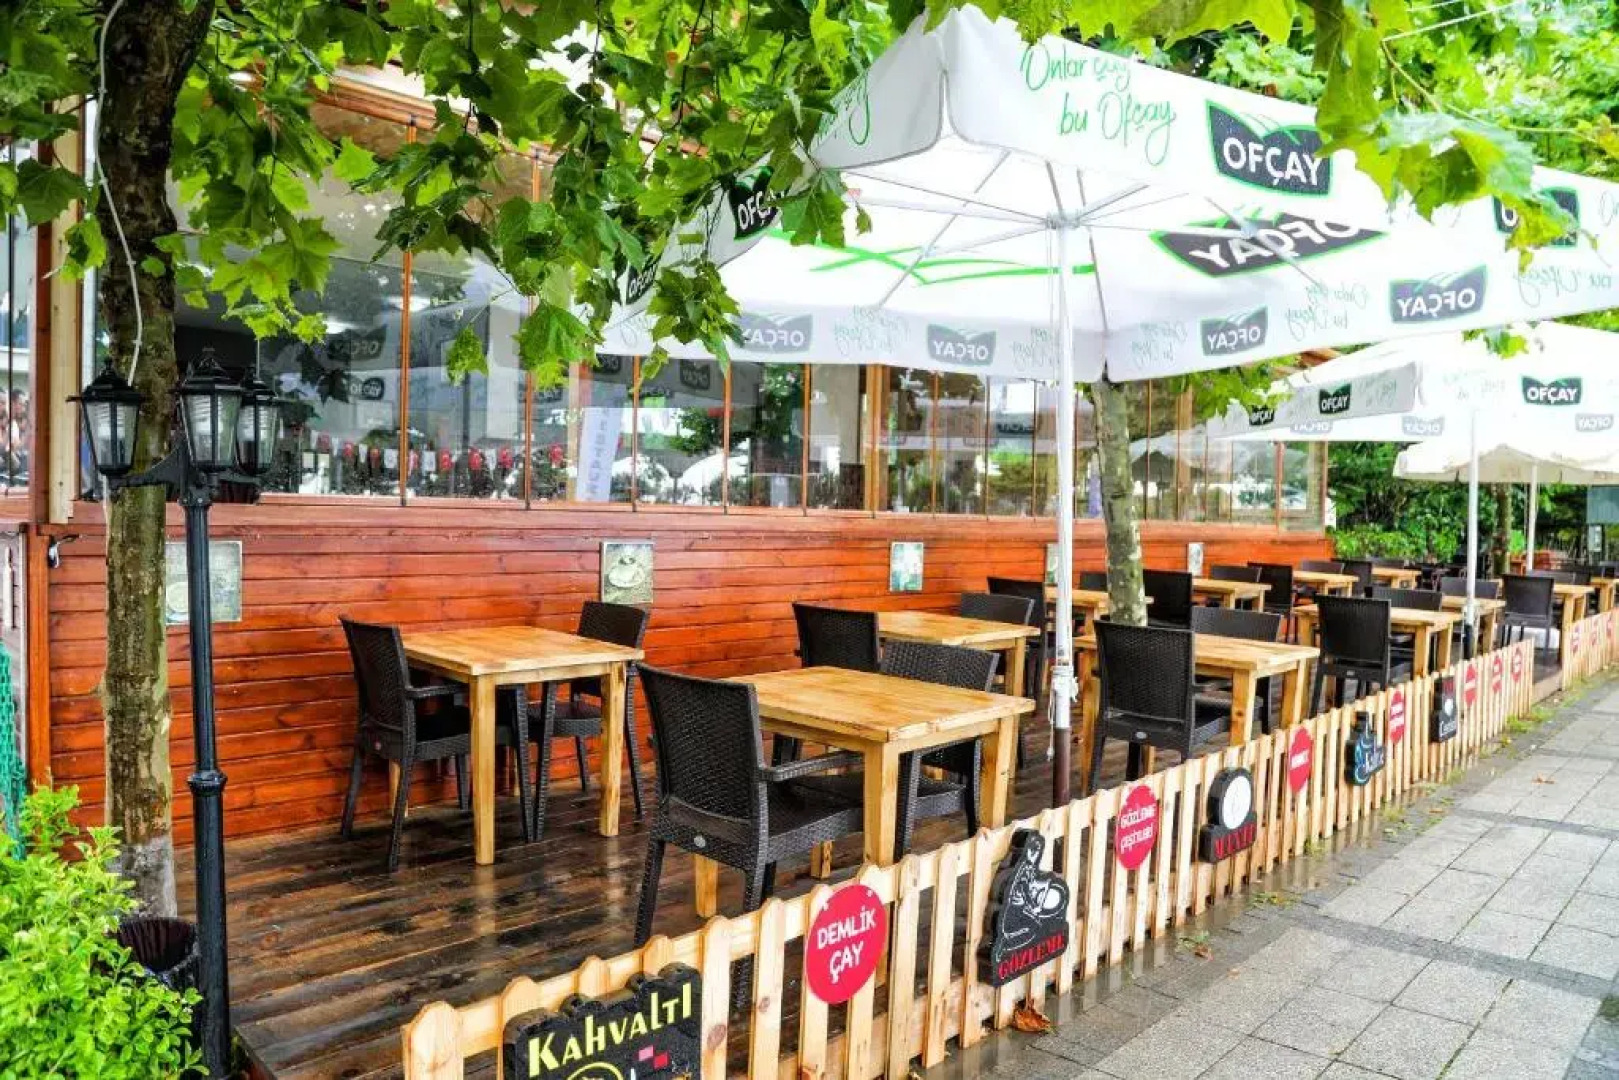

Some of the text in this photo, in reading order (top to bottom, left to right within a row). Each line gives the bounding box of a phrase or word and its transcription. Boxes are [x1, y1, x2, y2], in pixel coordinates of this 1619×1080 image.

[1020, 43, 1088, 90] Onlar
[1060, 91, 1177, 166] bu Ofçay
[1223, 137, 1323, 186] OFÇAY
[1526, 386, 1578, 404] OFÇAY
[817, 905, 877, 950] DEMLİK
[829, 940, 864, 985] ÇAY
